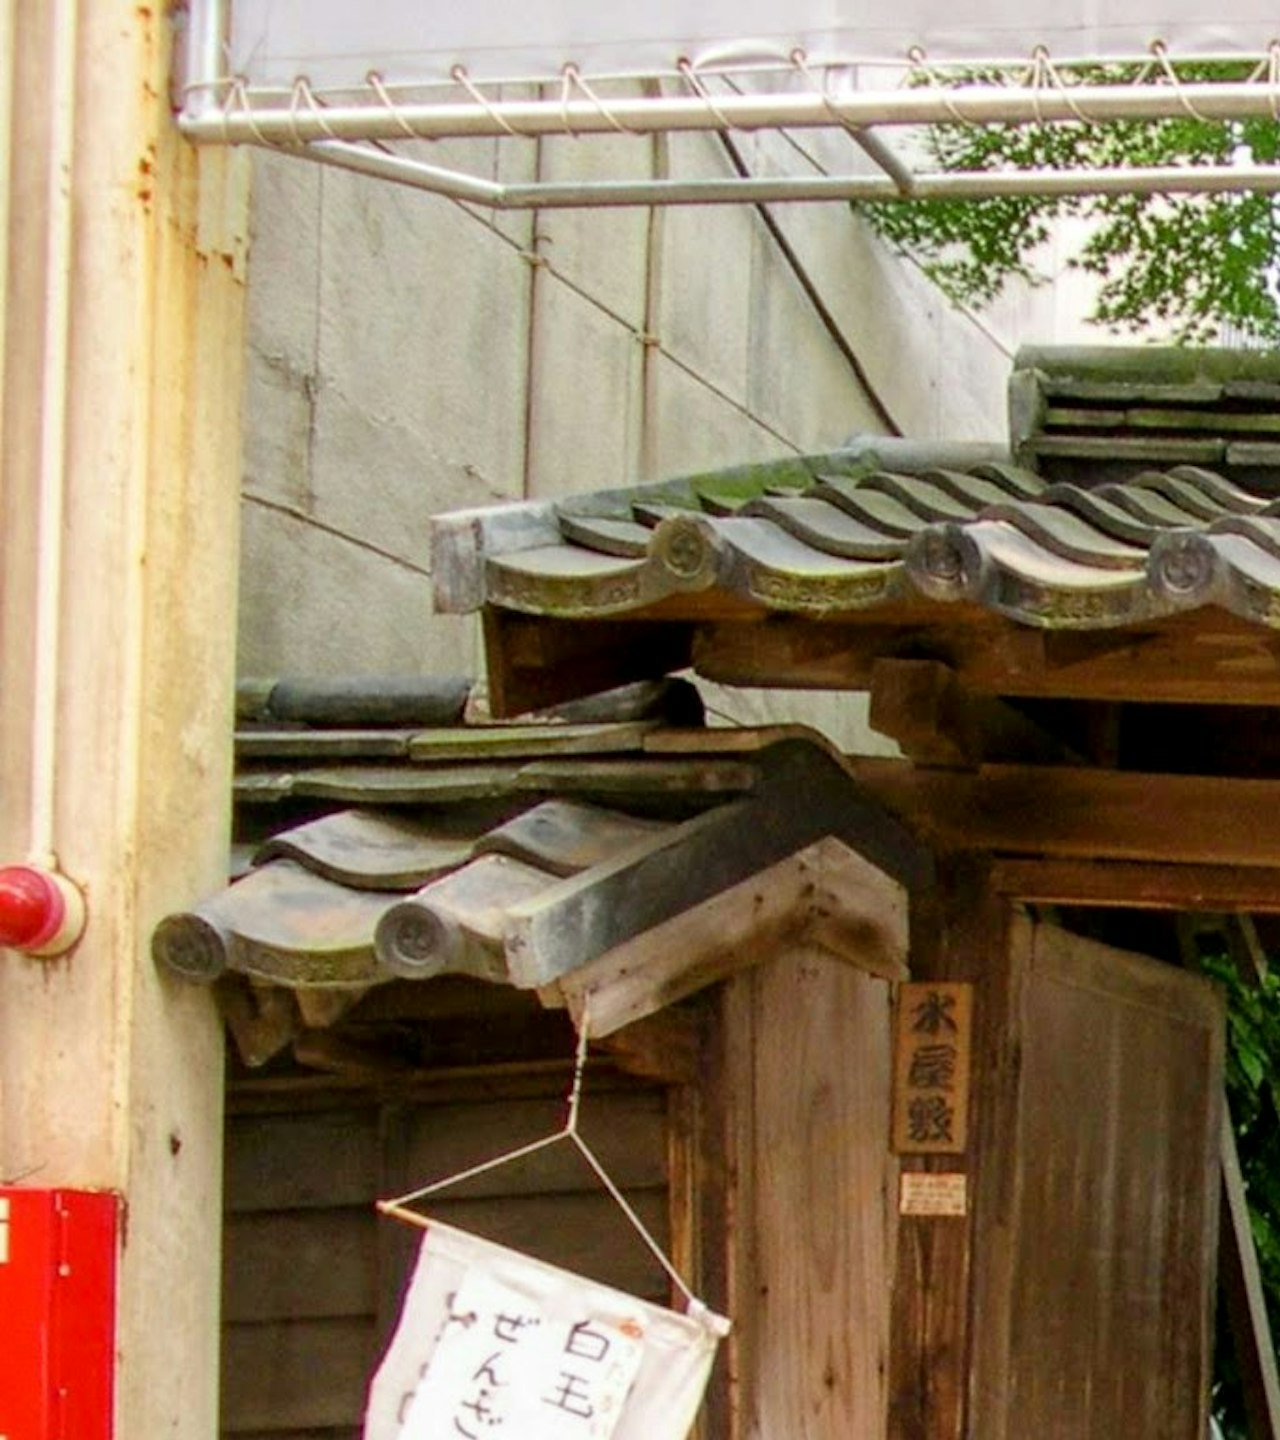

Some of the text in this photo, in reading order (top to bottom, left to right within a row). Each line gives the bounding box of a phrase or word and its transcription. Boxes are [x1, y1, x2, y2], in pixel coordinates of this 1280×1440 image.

[909, 990, 959, 1144] 水屋敷
[540, 1319, 611, 1420] 白玉
